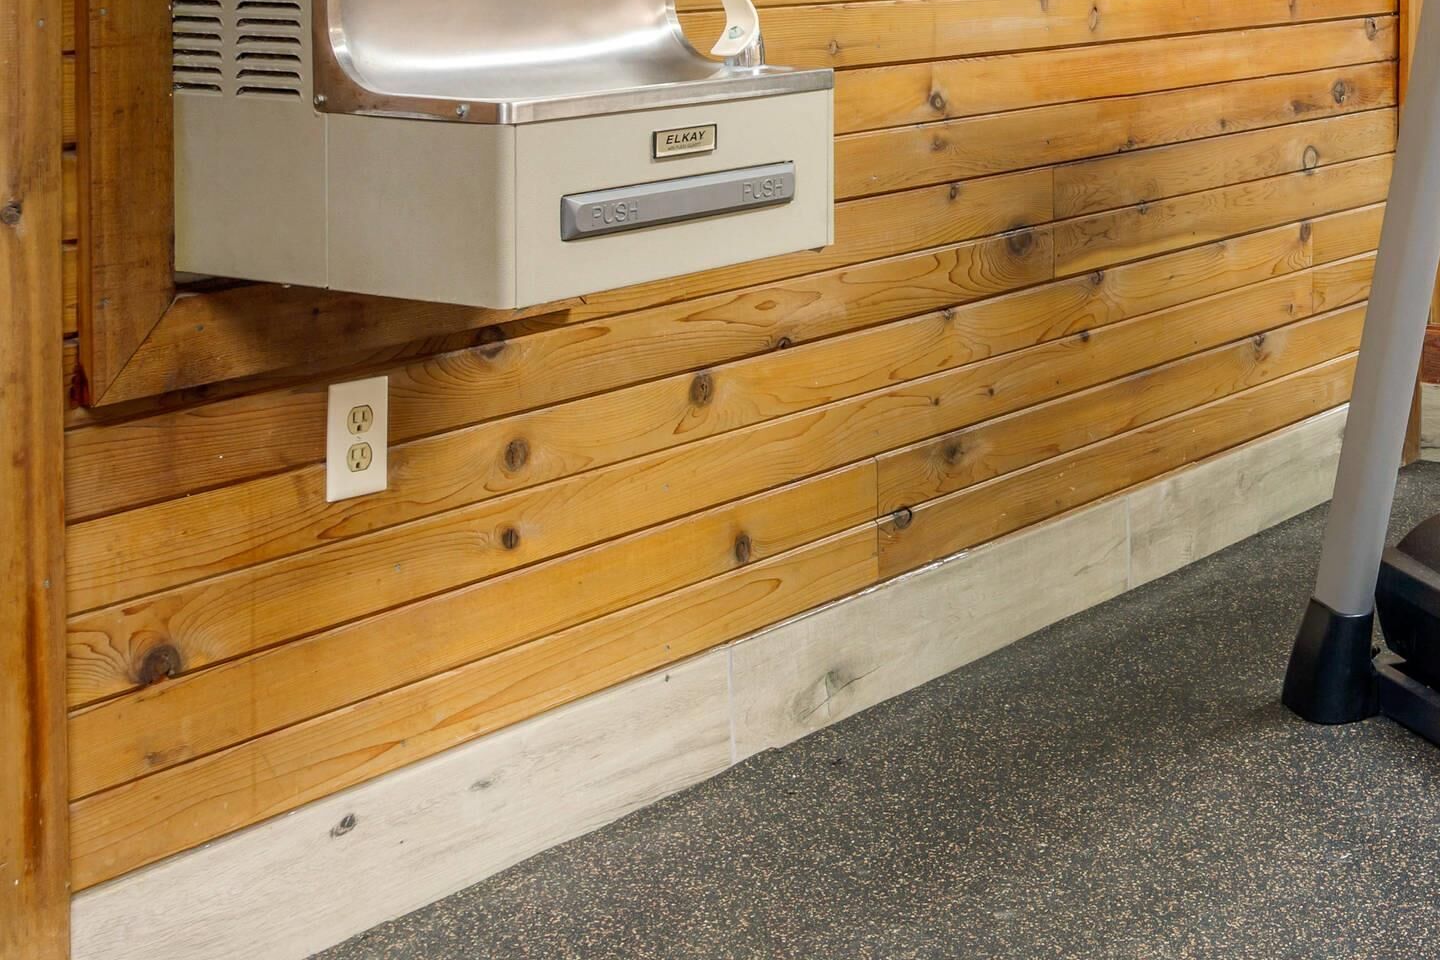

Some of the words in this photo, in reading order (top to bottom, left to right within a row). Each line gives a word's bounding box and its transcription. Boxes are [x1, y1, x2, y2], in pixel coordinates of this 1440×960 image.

[666, 130, 706, 145] ELKAY
[742, 177, 783, 203] PUSH
[591, 200, 639, 227] PUSH
